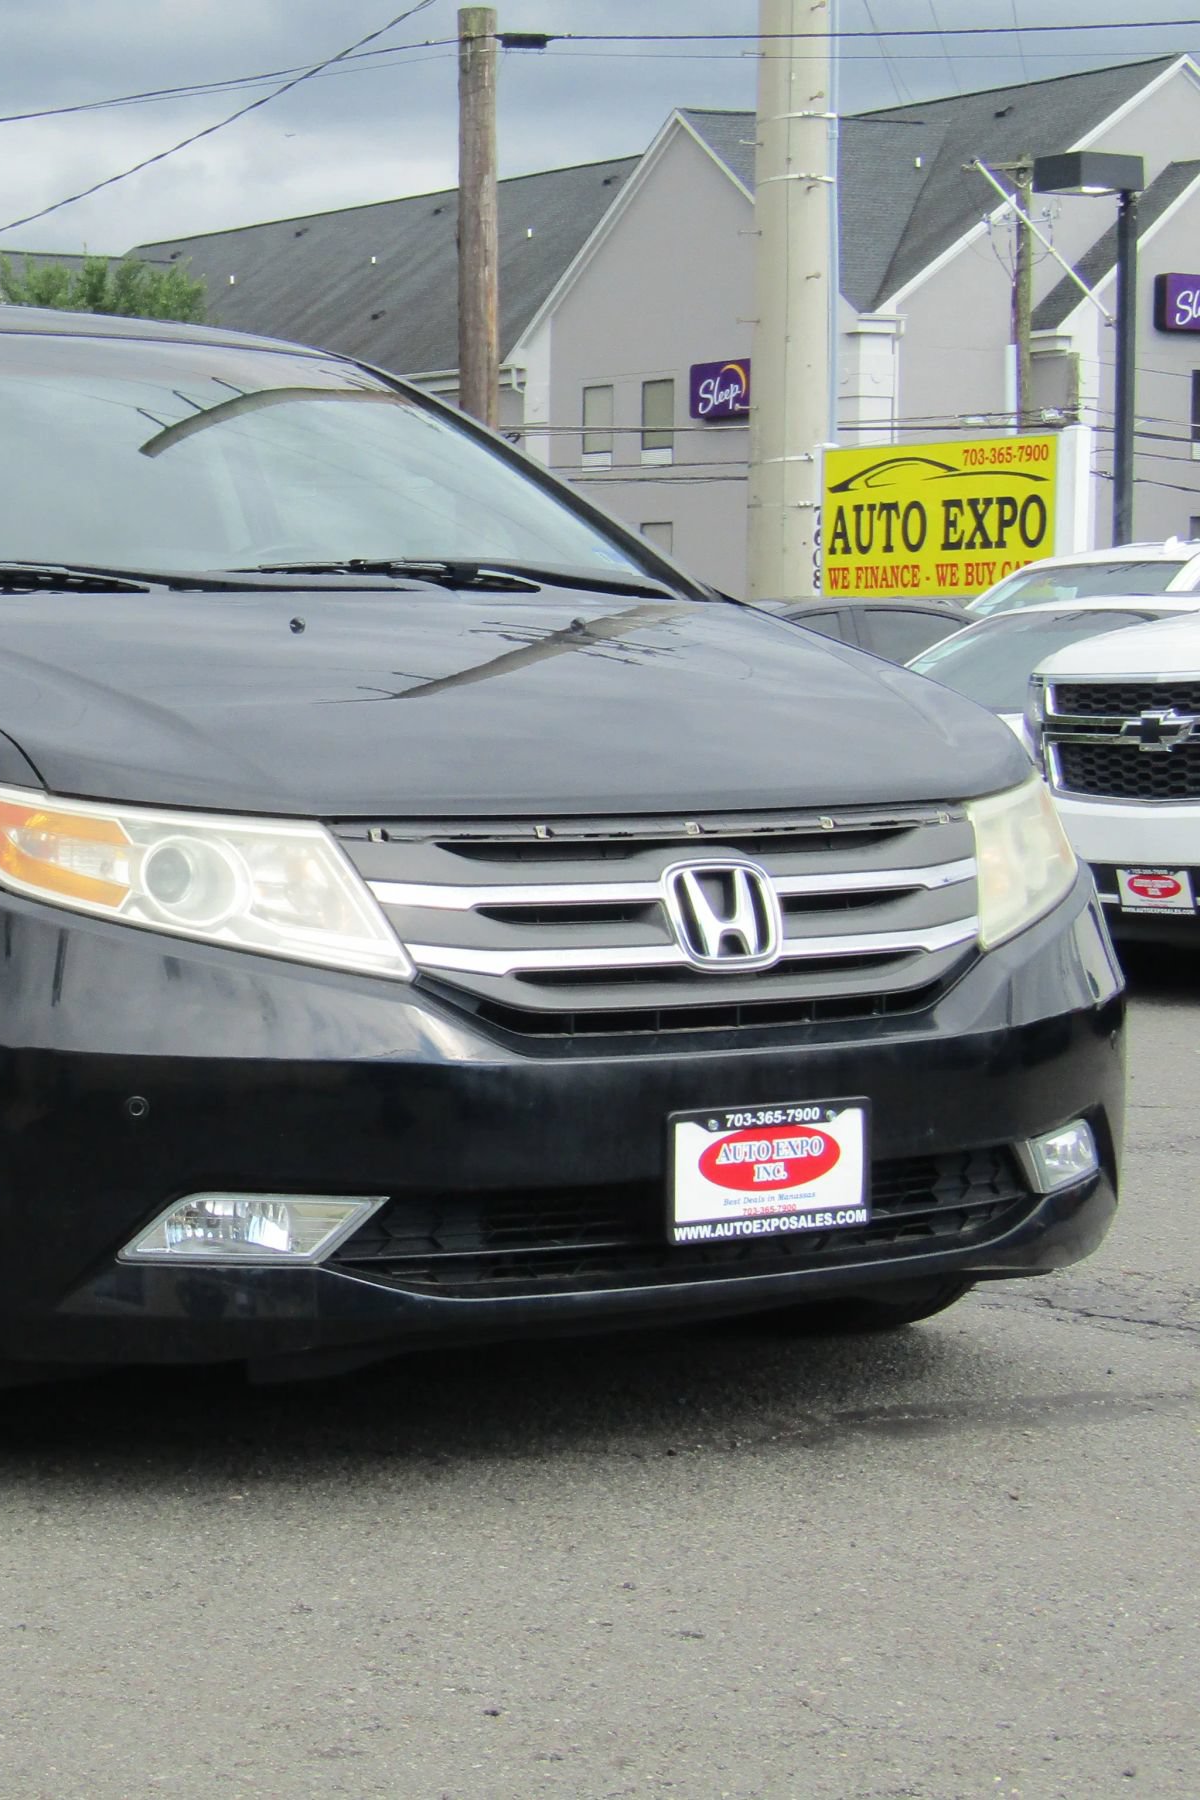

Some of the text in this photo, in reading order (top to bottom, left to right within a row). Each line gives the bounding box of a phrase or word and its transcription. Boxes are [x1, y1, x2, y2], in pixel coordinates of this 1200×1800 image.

[699, 377, 741, 414] Sleep
[963, 444, 1049, 465] 703-365-7900
[828, 494, 1047, 555] AUTO EXPO
[828, 567, 850, 590] WE
[855, 565, 920, 589] FINANCE
[936, 563, 959, 587] WE
[964, 562, 997, 586] BUY
[725, 1107, 820, 1127] 703-365-7900
[717, 1138, 822, 1163] AUTO EXPO
[755, 1164, 786, 1180] INC.
[743, 1204, 797, 1216] 703-365-7900
[674, 1209, 867, 1241] WWW.AUTOEXPOSALES.COM
